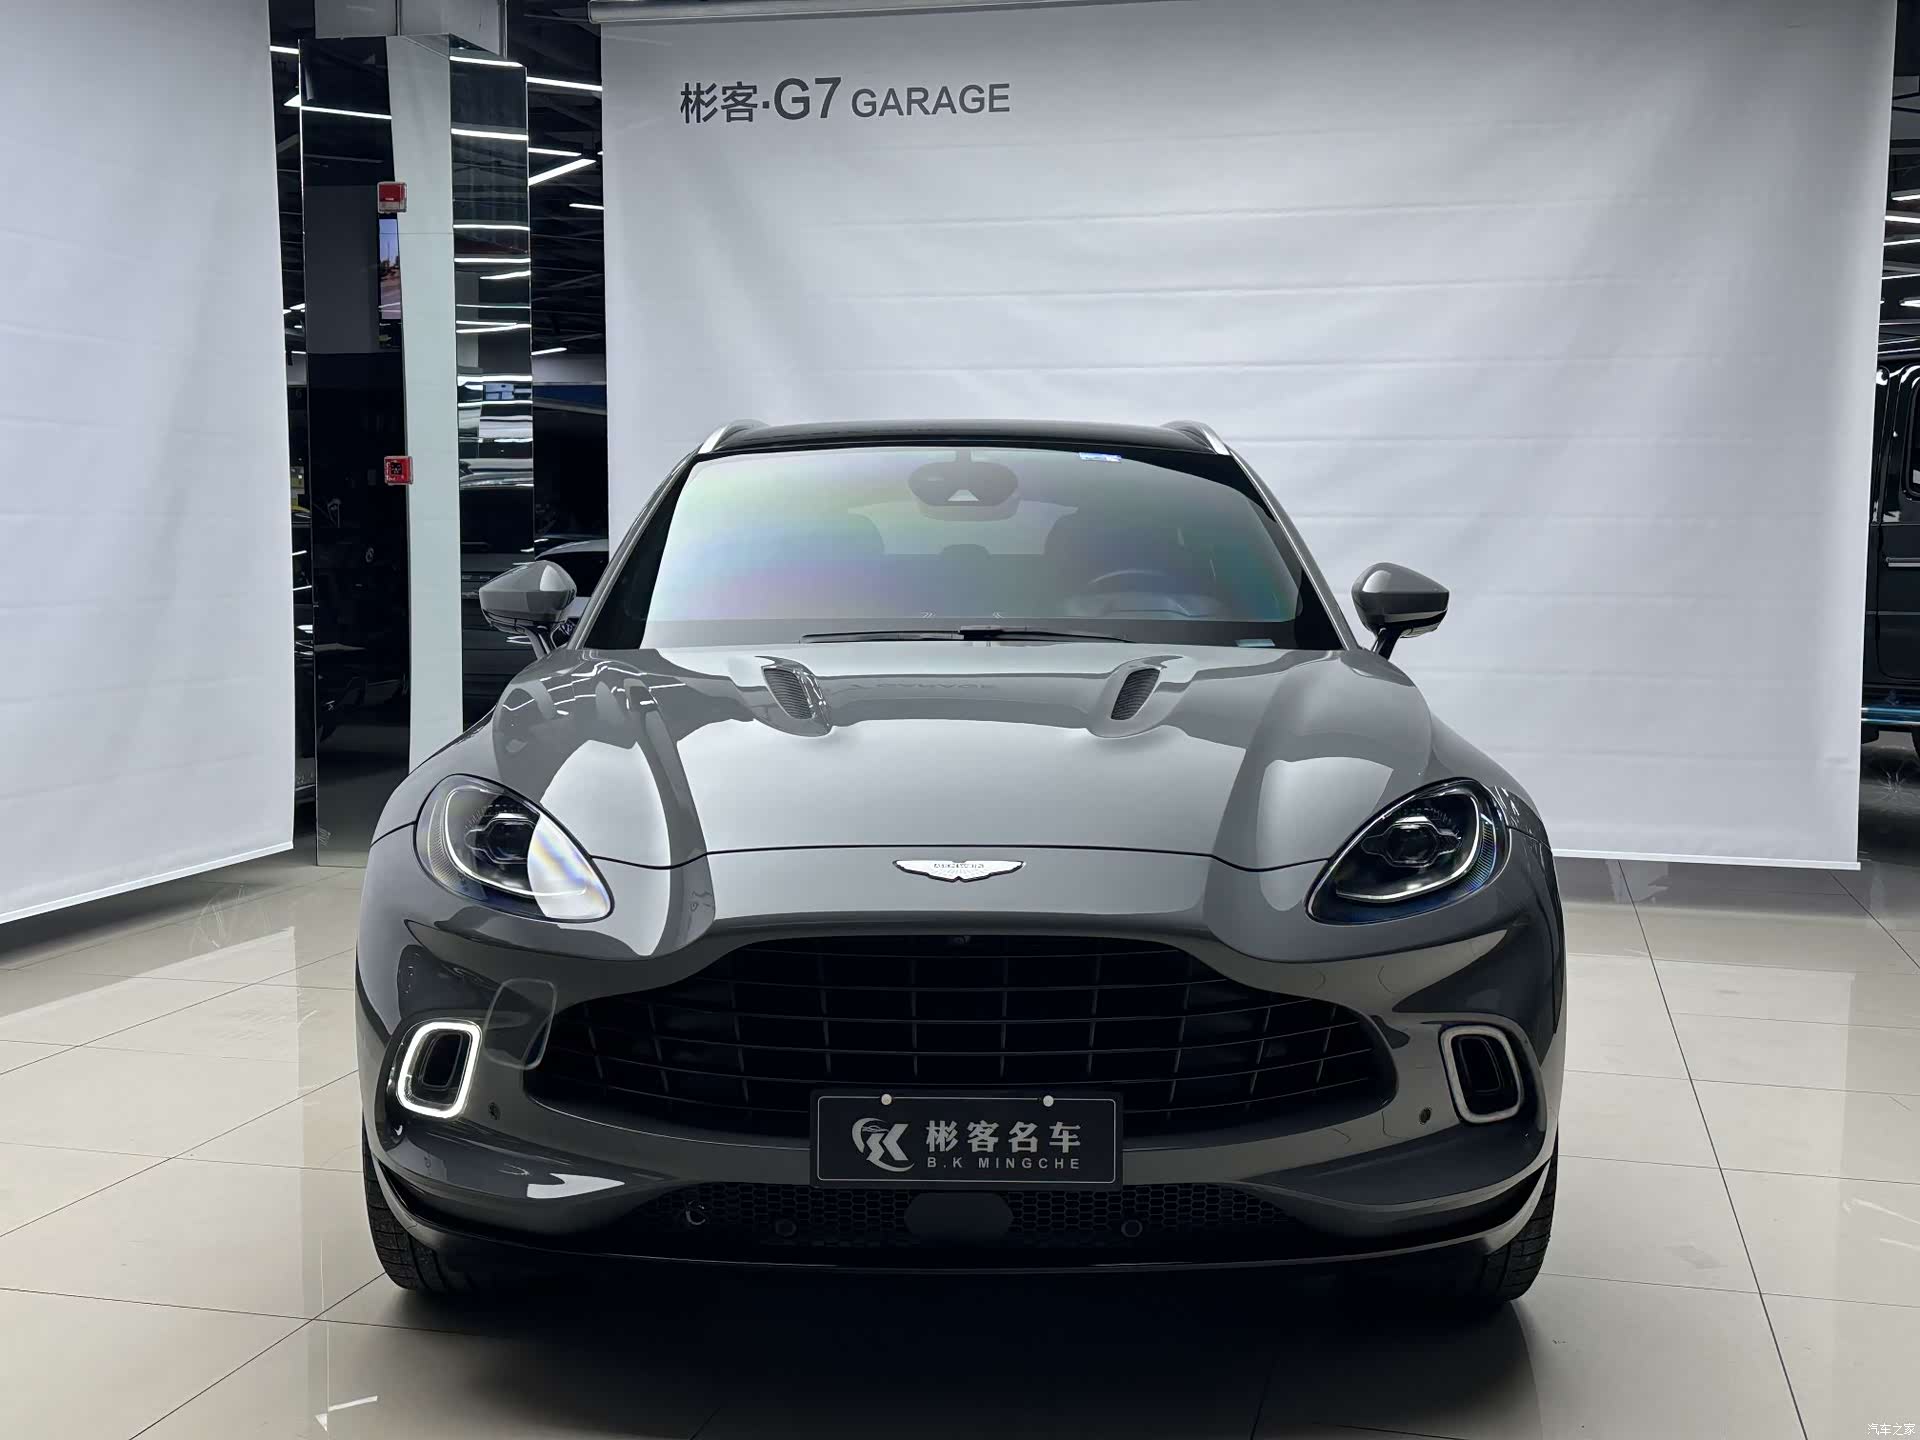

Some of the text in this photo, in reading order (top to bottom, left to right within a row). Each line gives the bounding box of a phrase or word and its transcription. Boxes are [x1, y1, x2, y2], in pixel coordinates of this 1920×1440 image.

[851, 83, 1010, 118] GARAGE
[925, 1120, 1081, 1153] 彬客名车
[927, 1156, 1080, 1169] B.K MINGCHE
